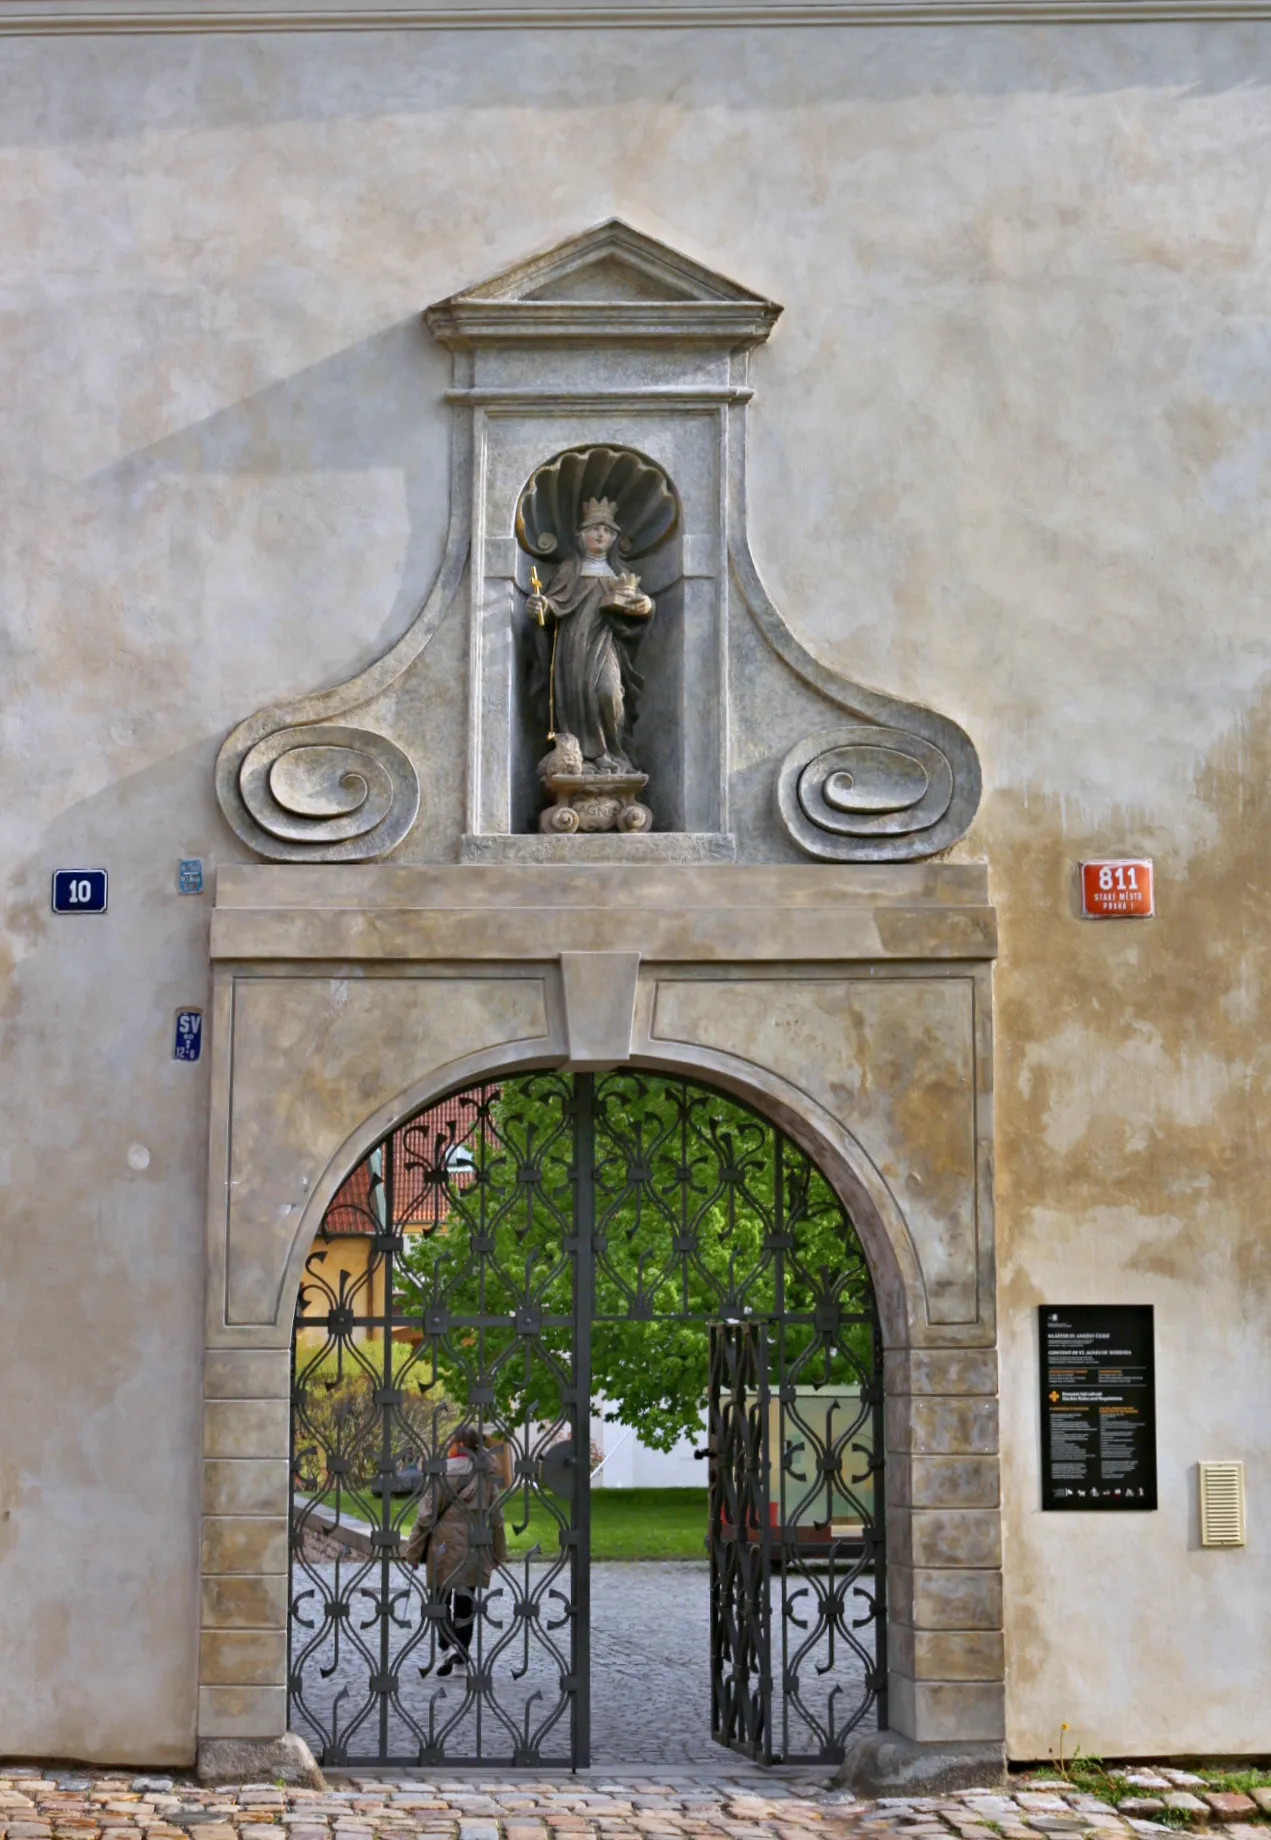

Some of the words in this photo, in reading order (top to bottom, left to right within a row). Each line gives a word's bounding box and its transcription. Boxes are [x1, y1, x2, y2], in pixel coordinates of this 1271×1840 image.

[1099, 866, 1138, 890] 811
[69, 880, 91, 903] 10
[1103, 902, 1127, 910] PRAHA
